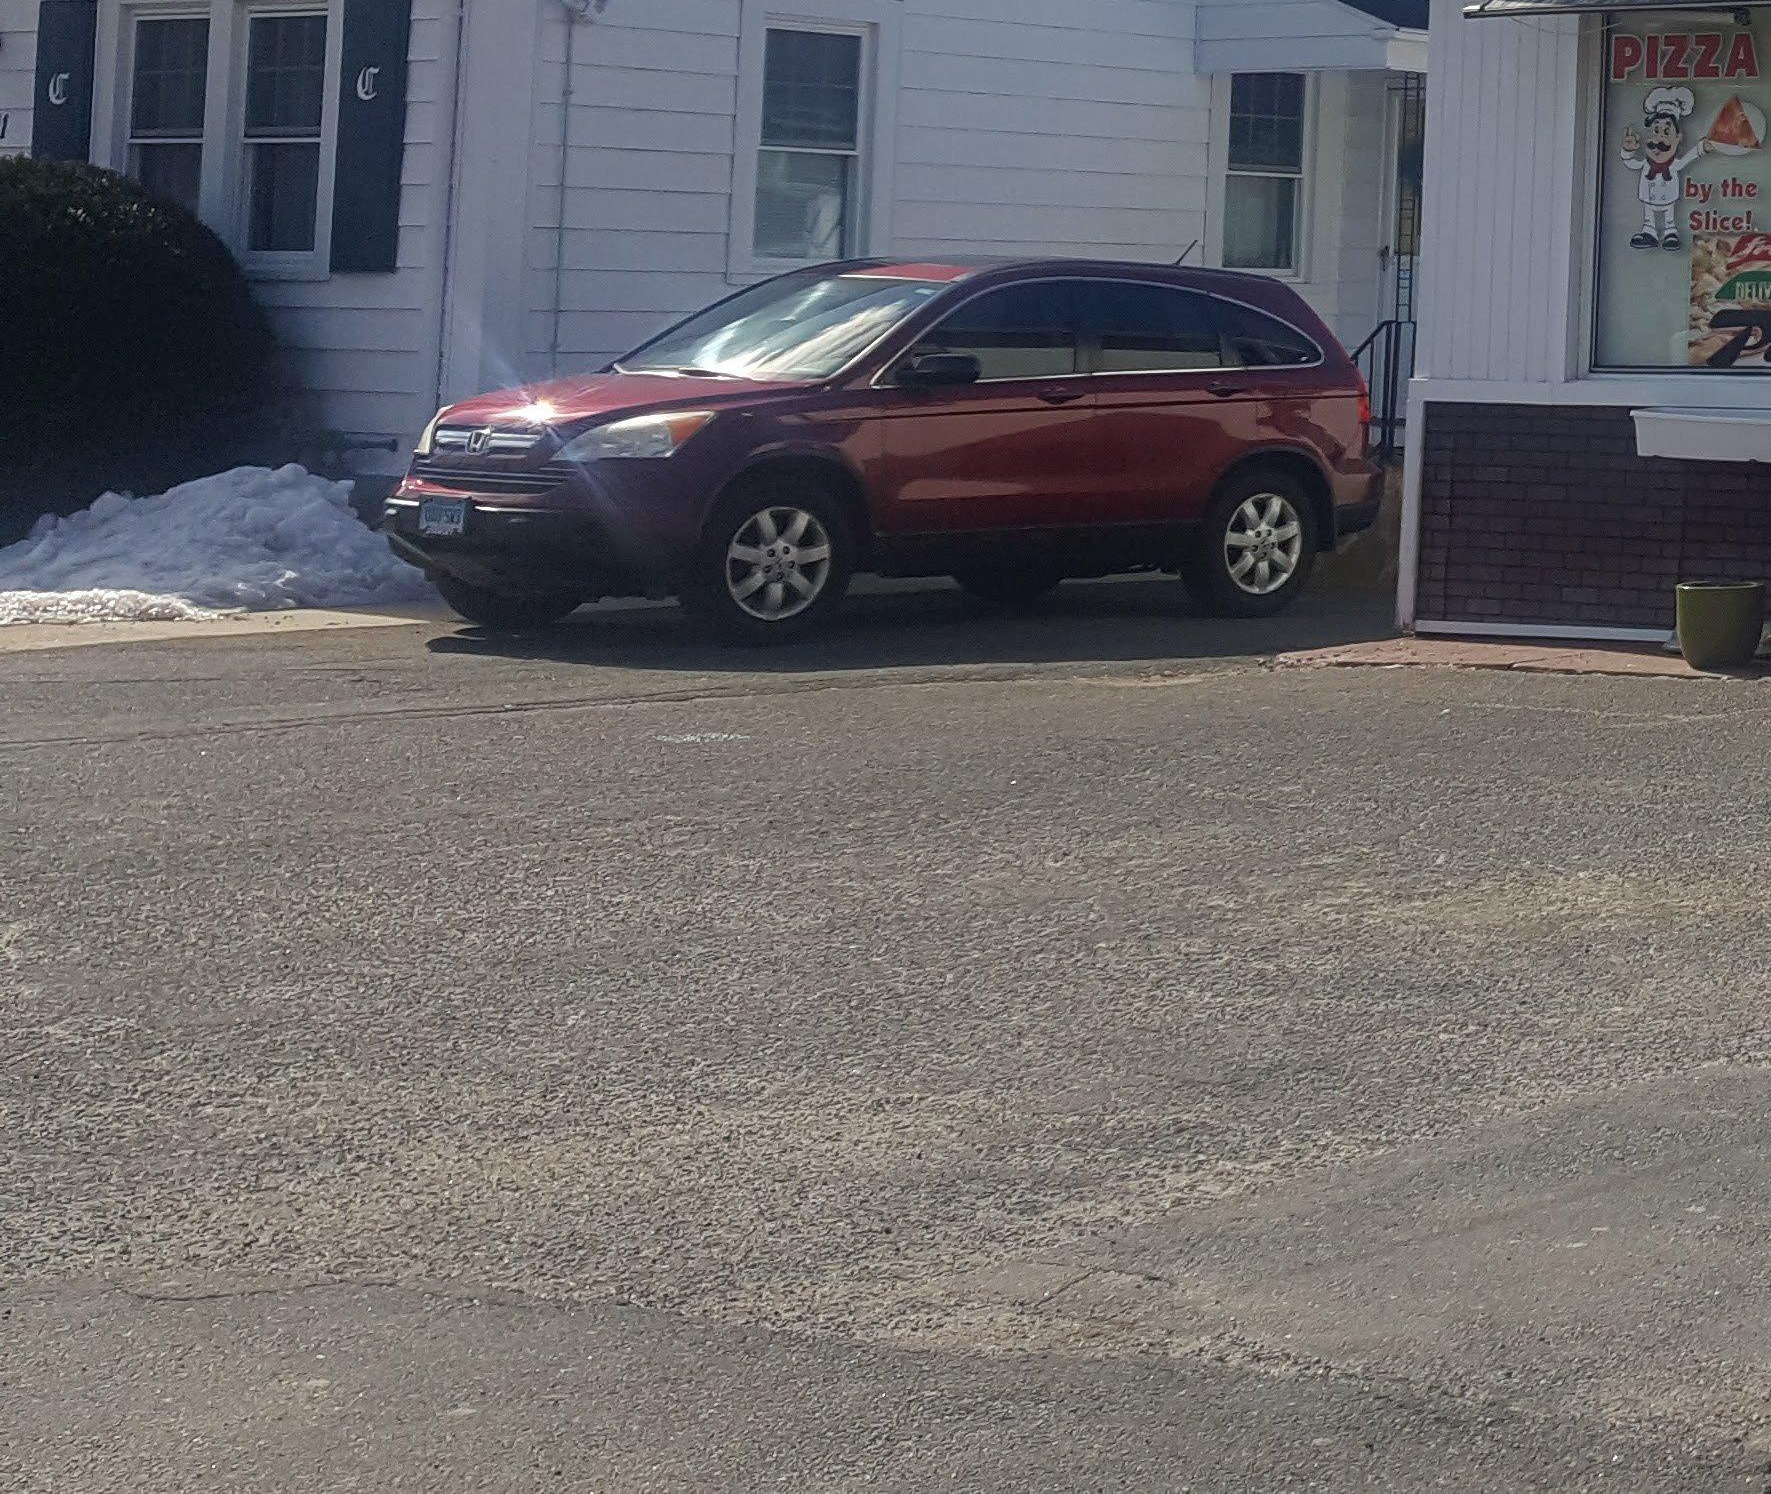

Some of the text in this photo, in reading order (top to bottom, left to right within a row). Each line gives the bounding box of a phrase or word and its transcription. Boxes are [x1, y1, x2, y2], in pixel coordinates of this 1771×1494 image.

[1611, 32, 1760, 81] PIZZA
[48, 72, 70, 105] C
[356, 66, 381, 101] C
[1685, 177, 1758, 204] by the
[1689, 209, 1753, 231] Slice!
